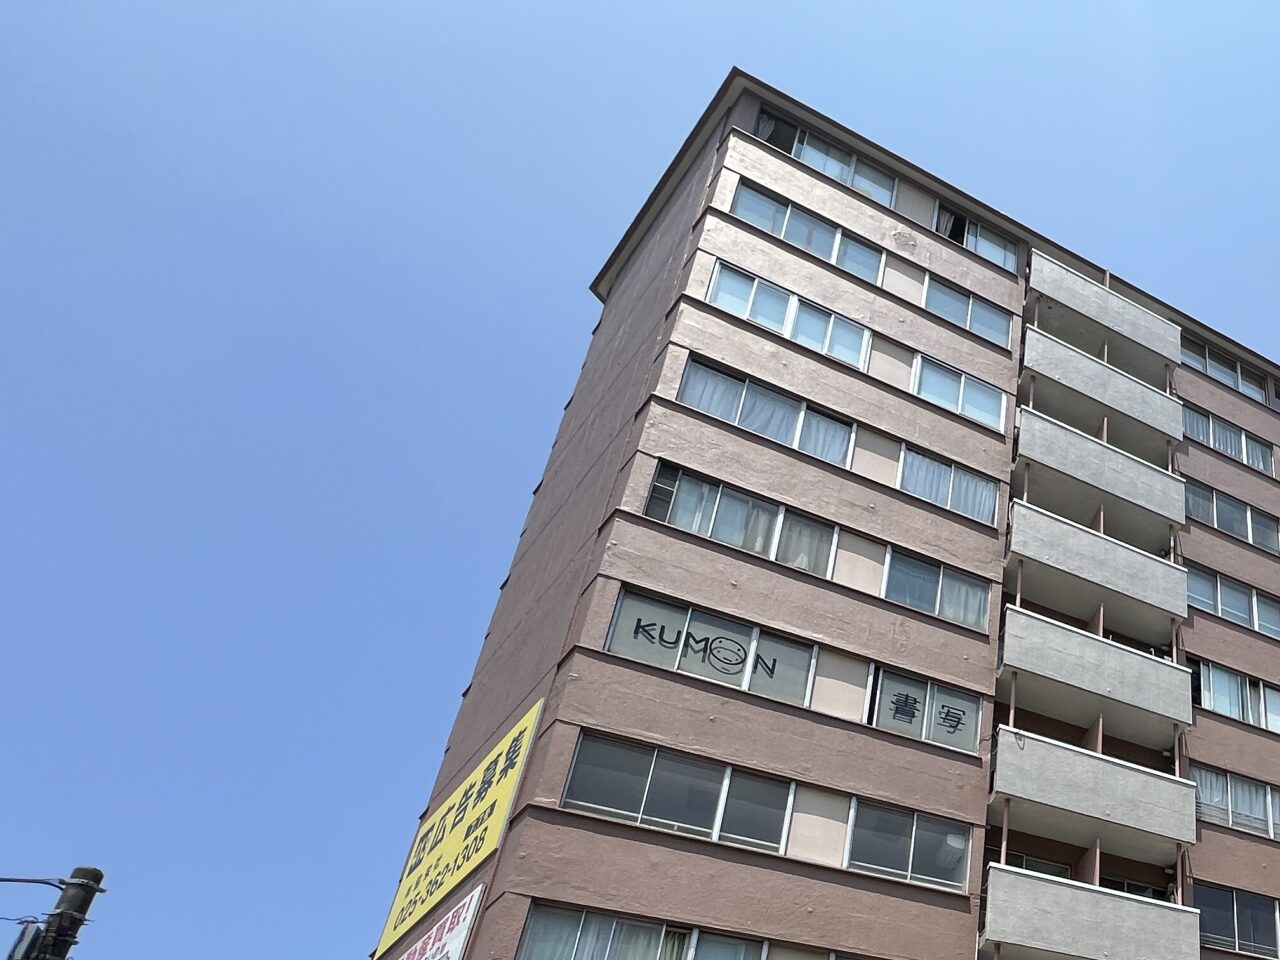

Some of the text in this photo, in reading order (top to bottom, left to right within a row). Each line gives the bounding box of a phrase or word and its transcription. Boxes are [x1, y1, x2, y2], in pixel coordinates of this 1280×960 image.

[633, 618, 778, 678] KUMON
[890, 692, 967, 735] 書写
[393, 825, 489, 931] 025-362-1308
